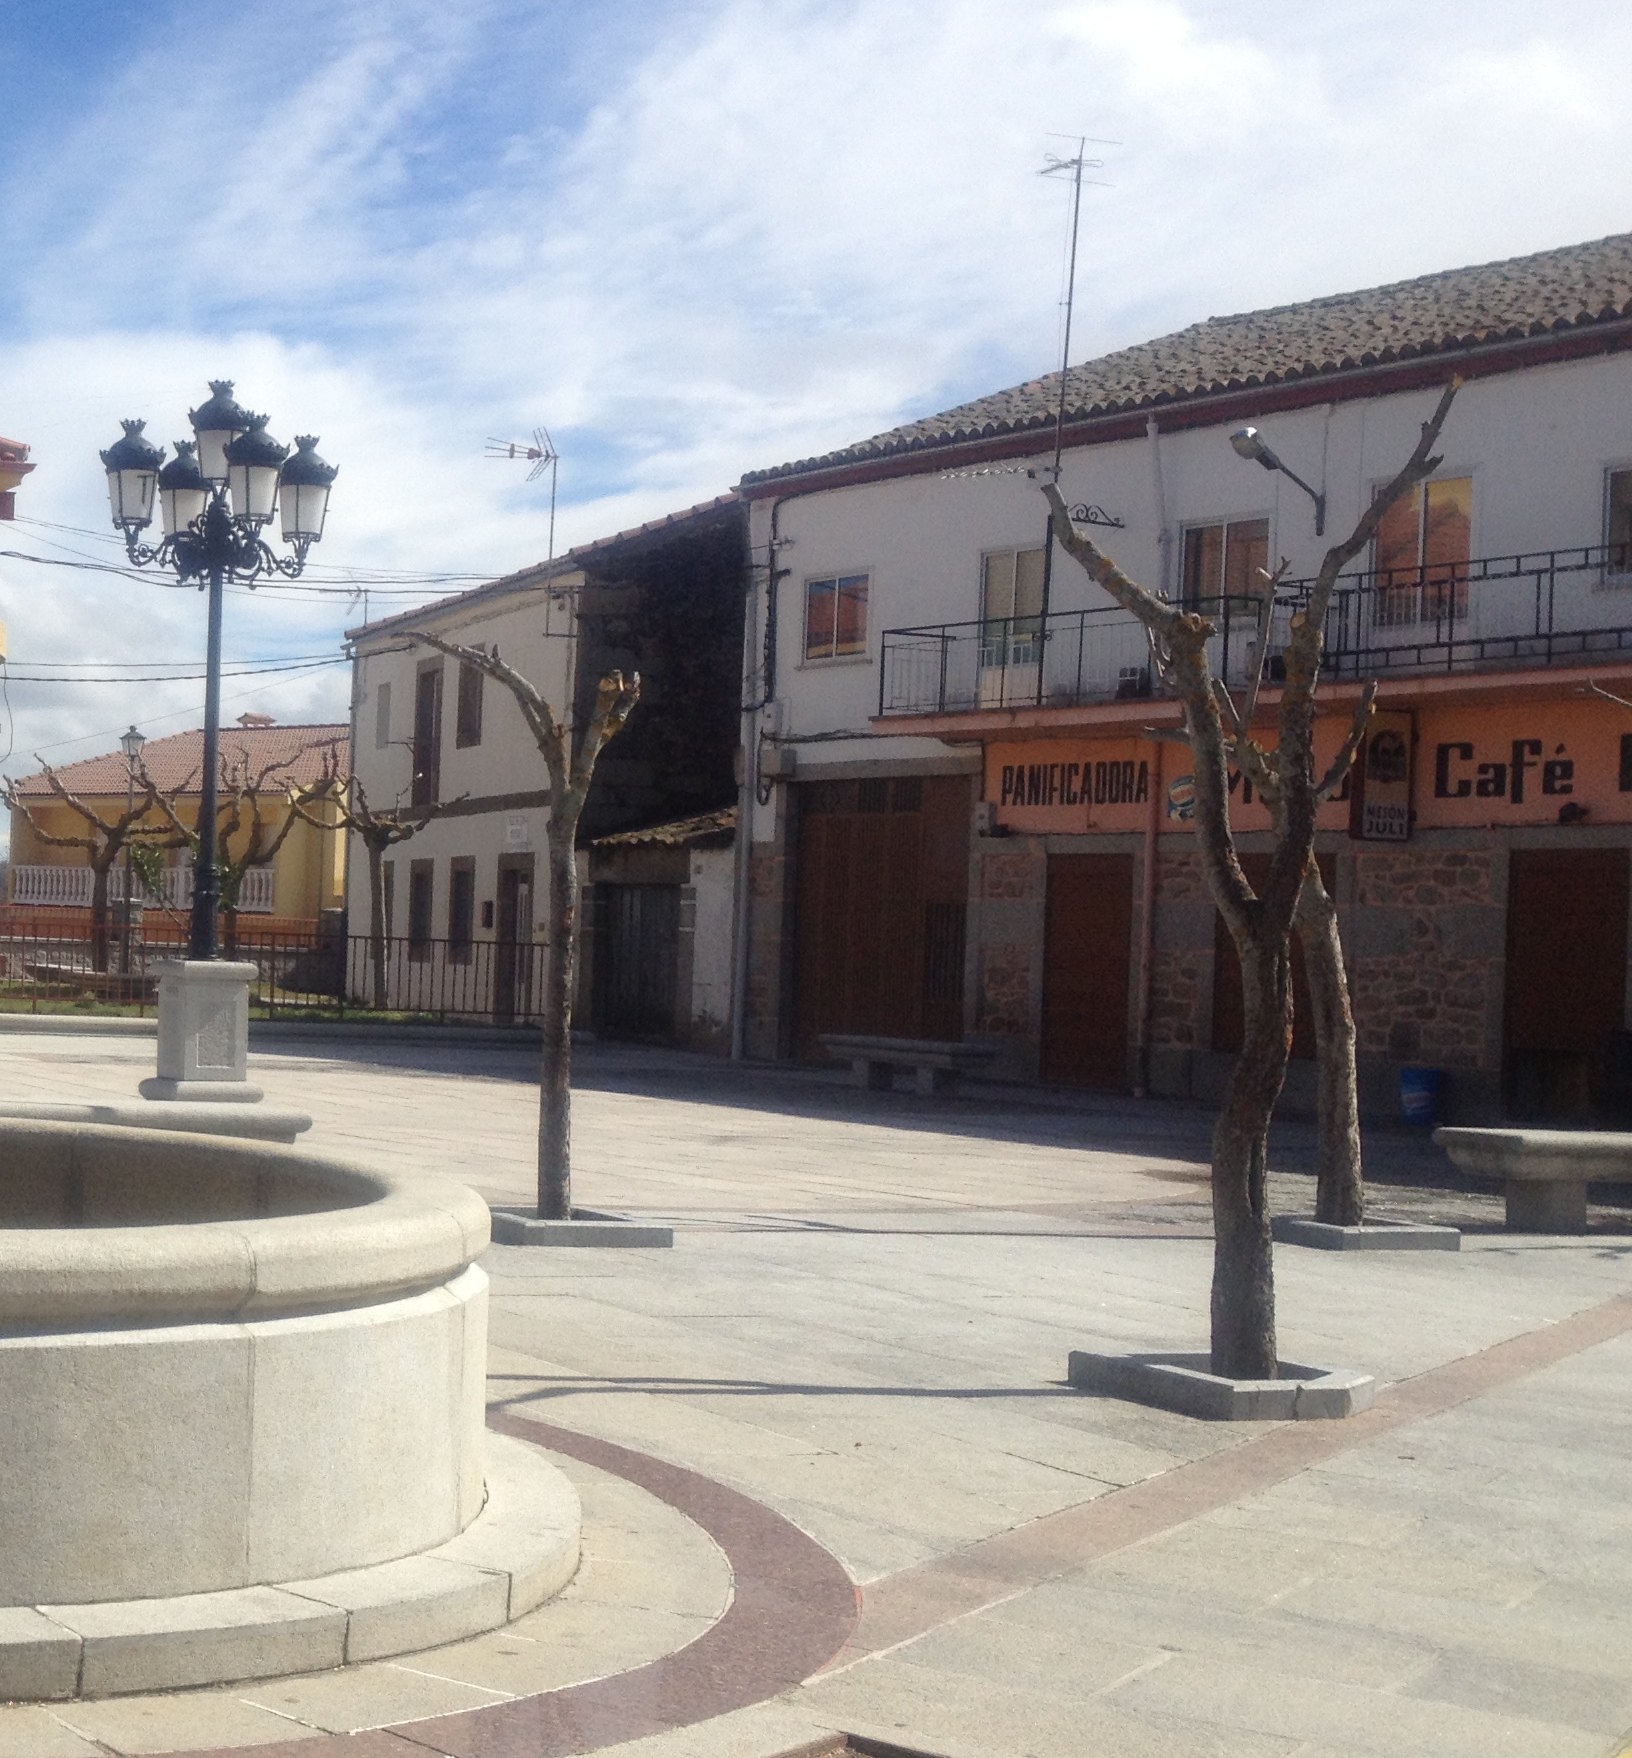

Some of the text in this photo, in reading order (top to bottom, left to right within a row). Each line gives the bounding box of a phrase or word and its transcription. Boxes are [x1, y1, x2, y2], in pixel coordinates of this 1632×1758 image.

[1000, 759, 1149, 807] PANIFICADORA
[1435, 738, 1574, 804] Café
[1366, 820, 1404, 836] JULI
